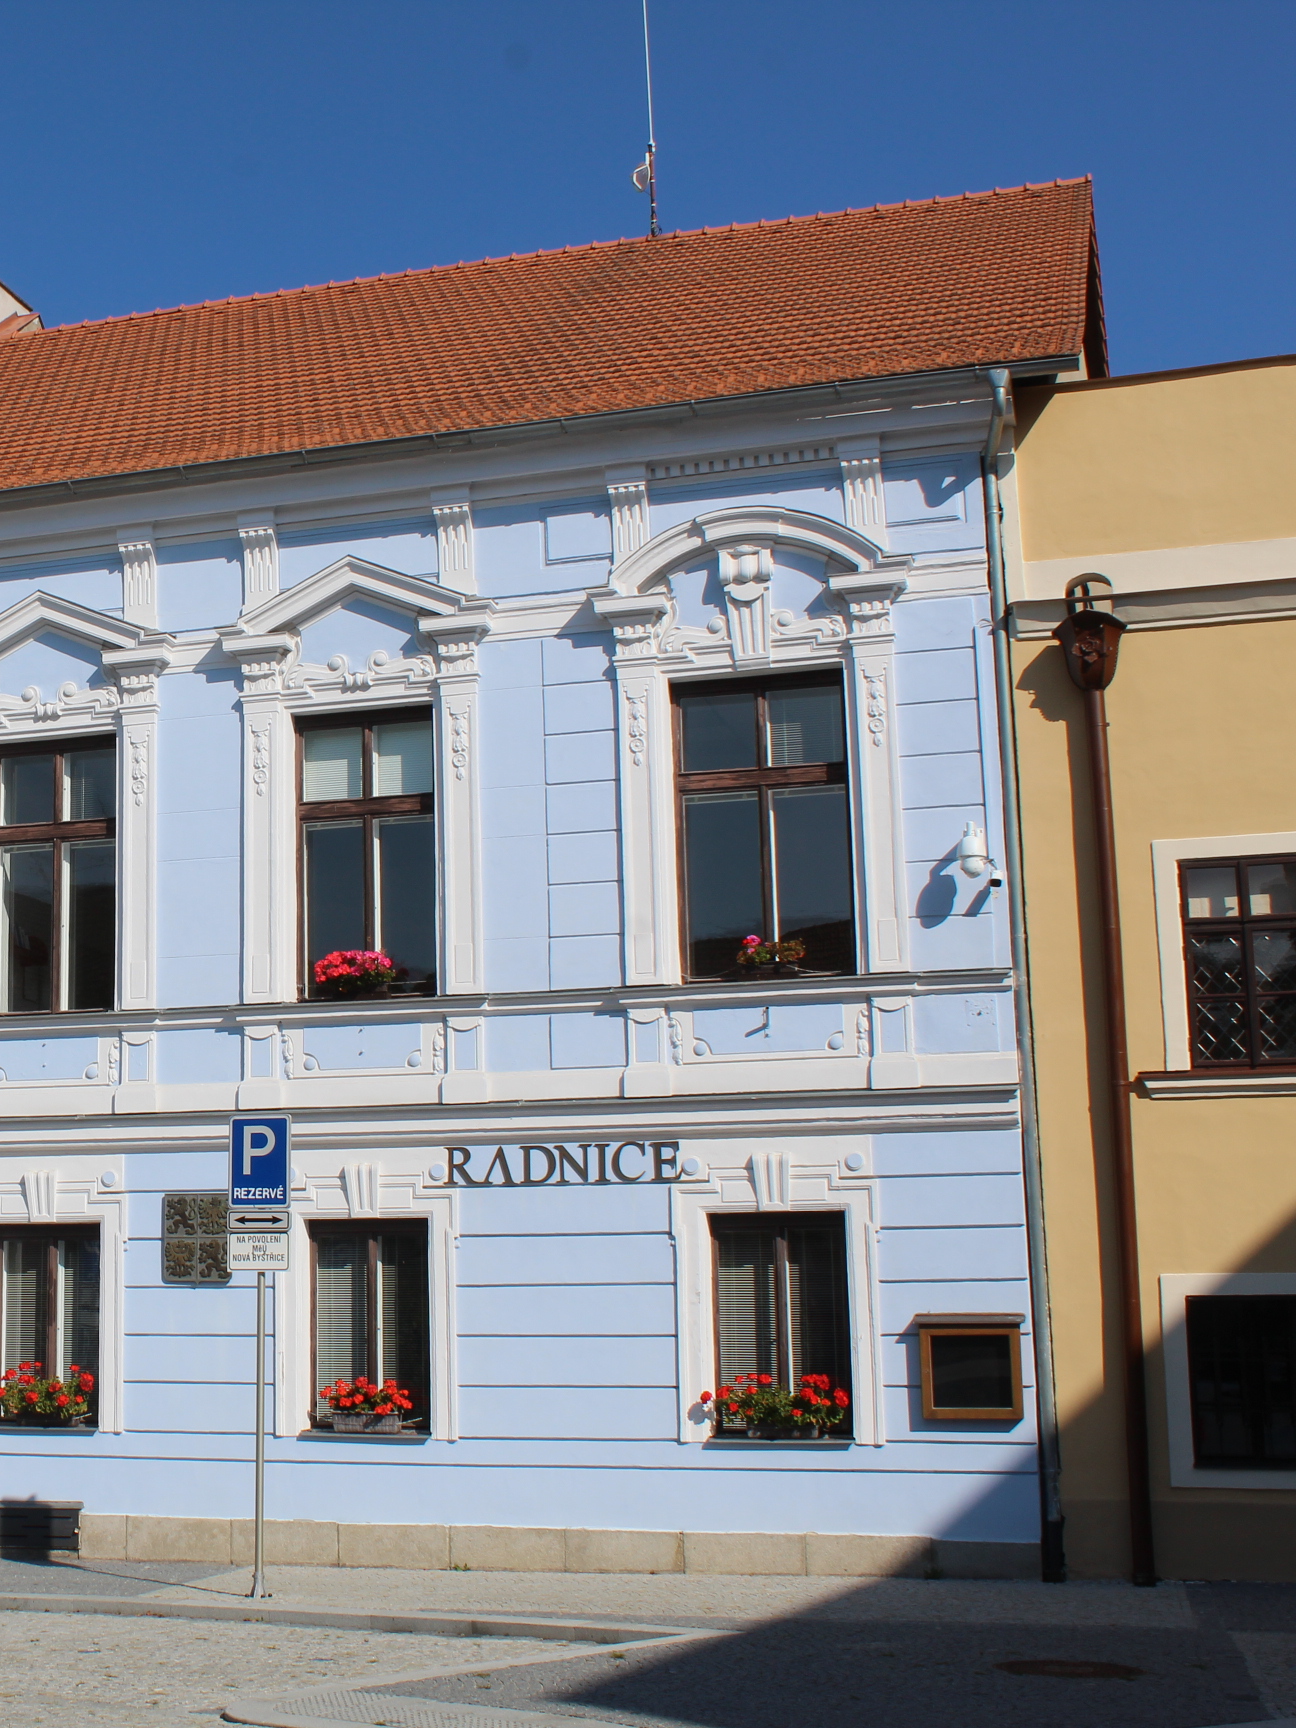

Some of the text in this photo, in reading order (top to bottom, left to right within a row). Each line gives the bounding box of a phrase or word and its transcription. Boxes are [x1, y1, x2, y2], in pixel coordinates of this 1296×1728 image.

[242, 1125, 276, 1175] P
[443, 1141, 684, 1185] RADNICE
[233, 1185, 284, 1199] REZERVÉ
[236, 1233, 282, 1244] NA POVOLENÍ
[232, 1251, 286, 1262] NOVÁ BYSTŘICE
